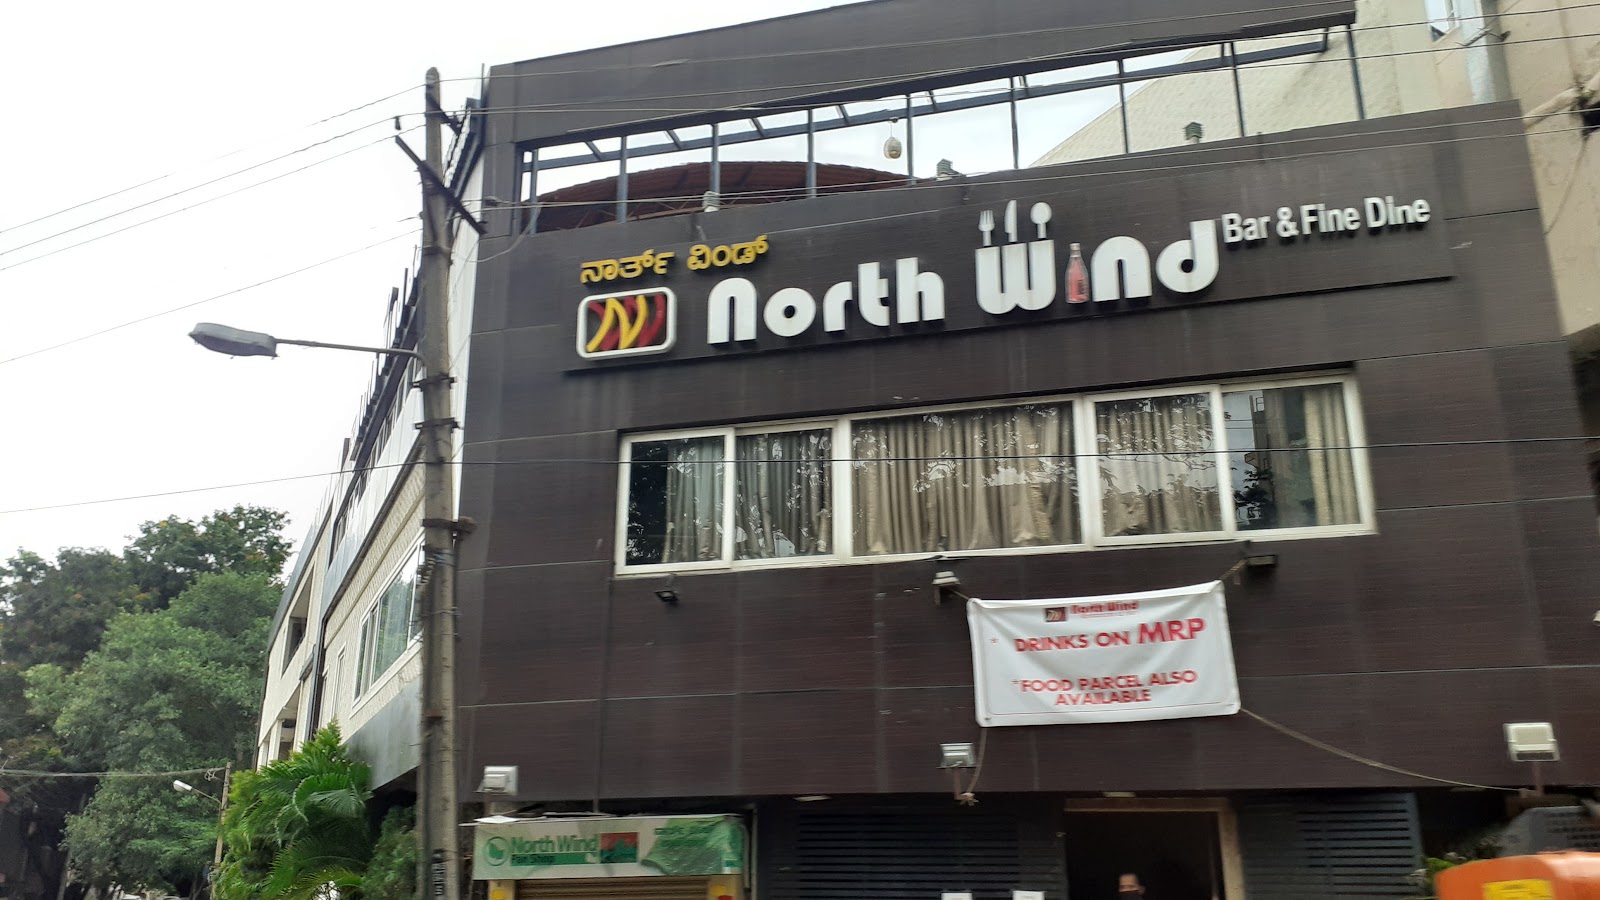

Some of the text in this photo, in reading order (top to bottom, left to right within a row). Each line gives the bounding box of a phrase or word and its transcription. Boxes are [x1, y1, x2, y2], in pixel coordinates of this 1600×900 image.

[1221, 195, 1431, 243] Bar & Fine Dine
[707, 256, 946, 345] North
[1014, 618, 1206, 652] DRINKS ON MRP
[1079, 674, 1143, 690] PARCEL
[1151, 670, 1198, 686] ALSO
[1055, 690, 1152, 706] AVAILABLE
